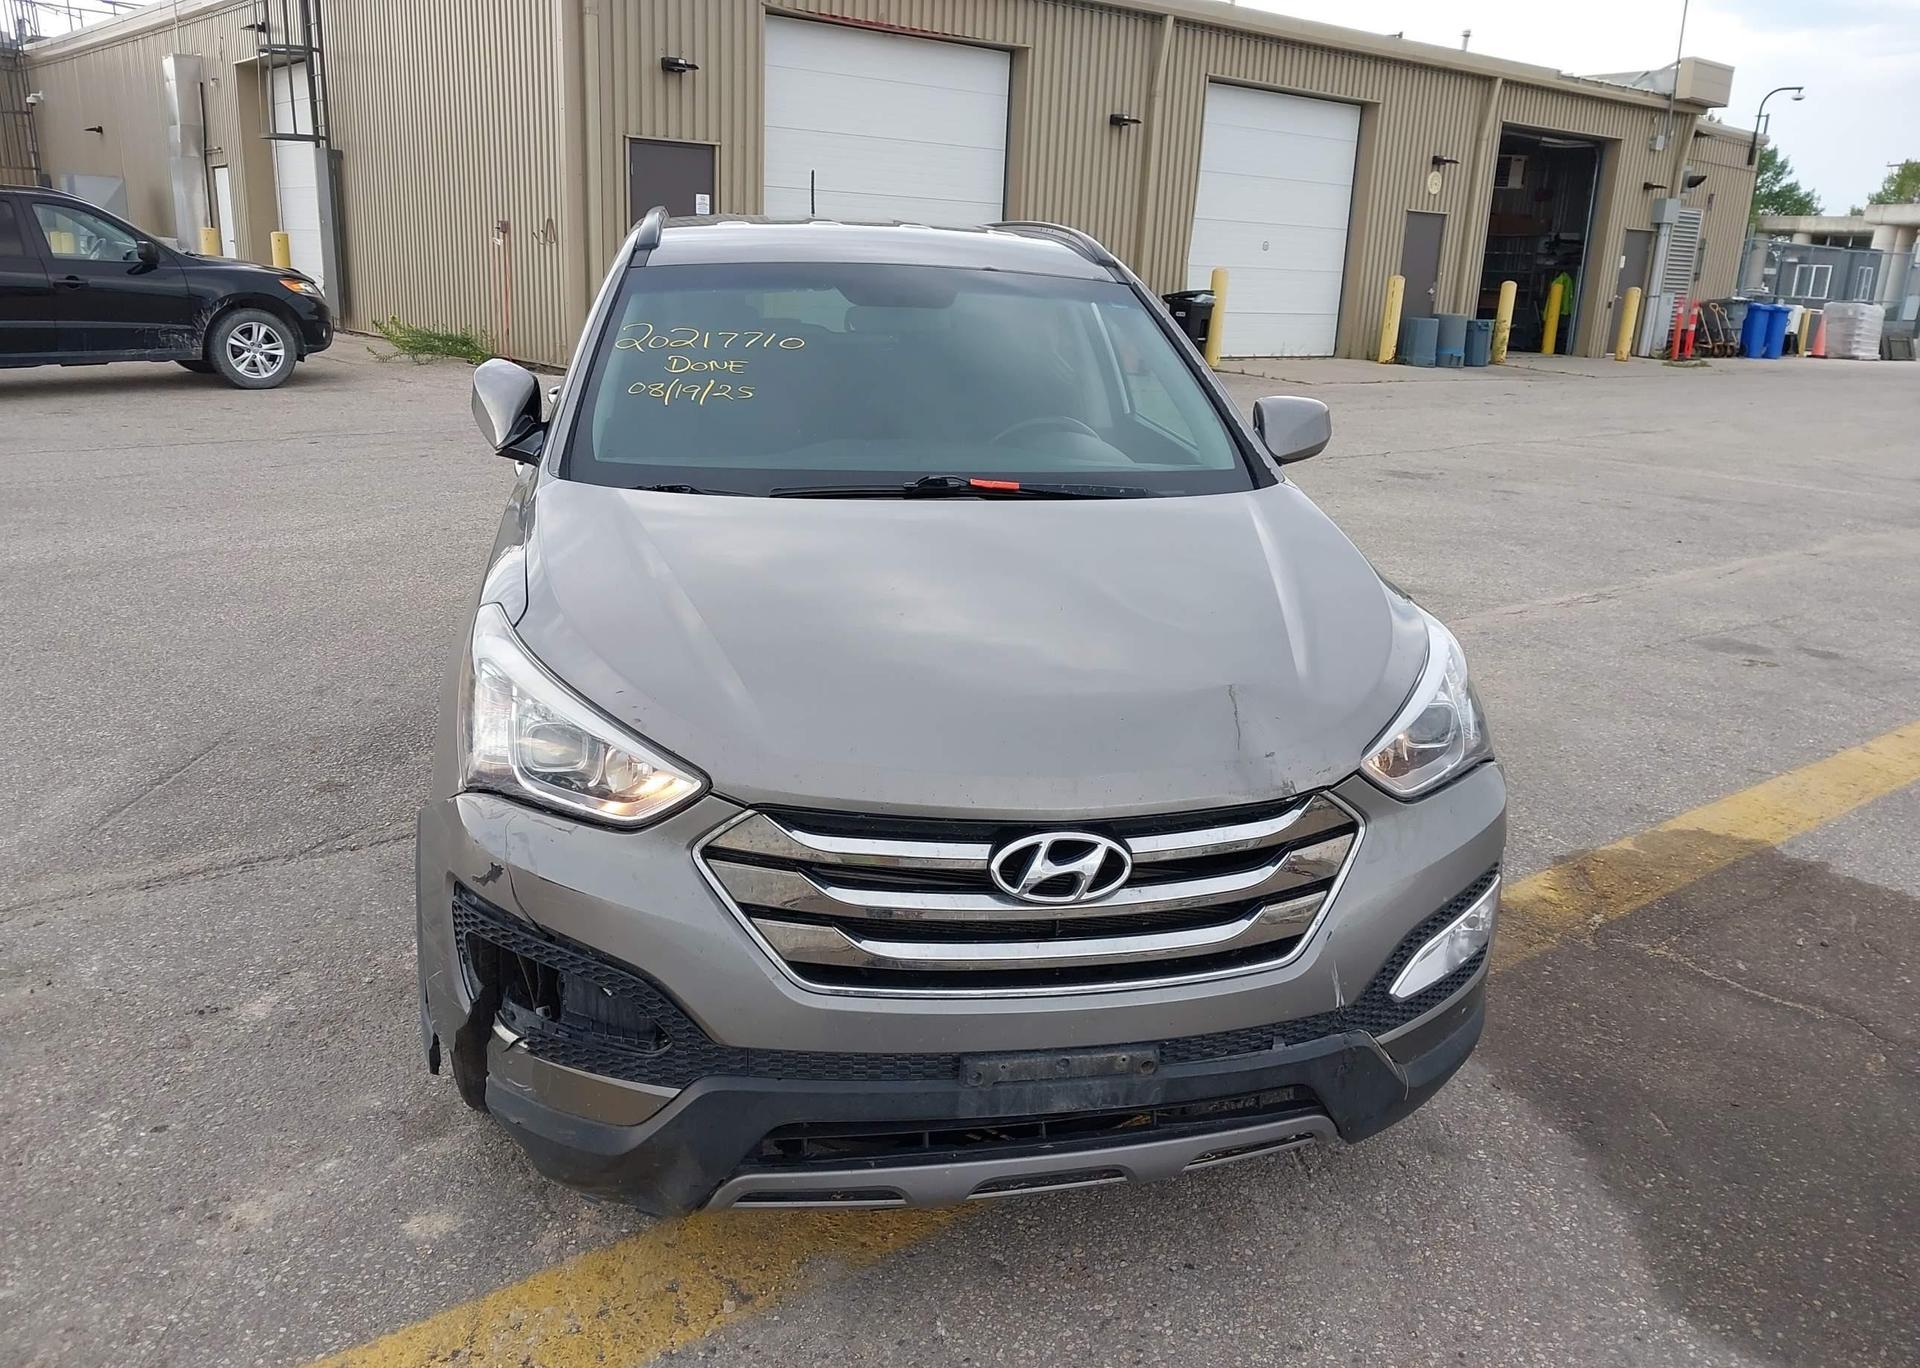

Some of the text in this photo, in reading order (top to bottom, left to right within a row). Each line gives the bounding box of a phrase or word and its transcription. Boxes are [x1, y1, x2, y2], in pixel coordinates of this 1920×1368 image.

[615, 322, 805, 352] 20217710
[664, 355, 749, 373] DONE
[627, 378, 756, 406] 08/19/25
